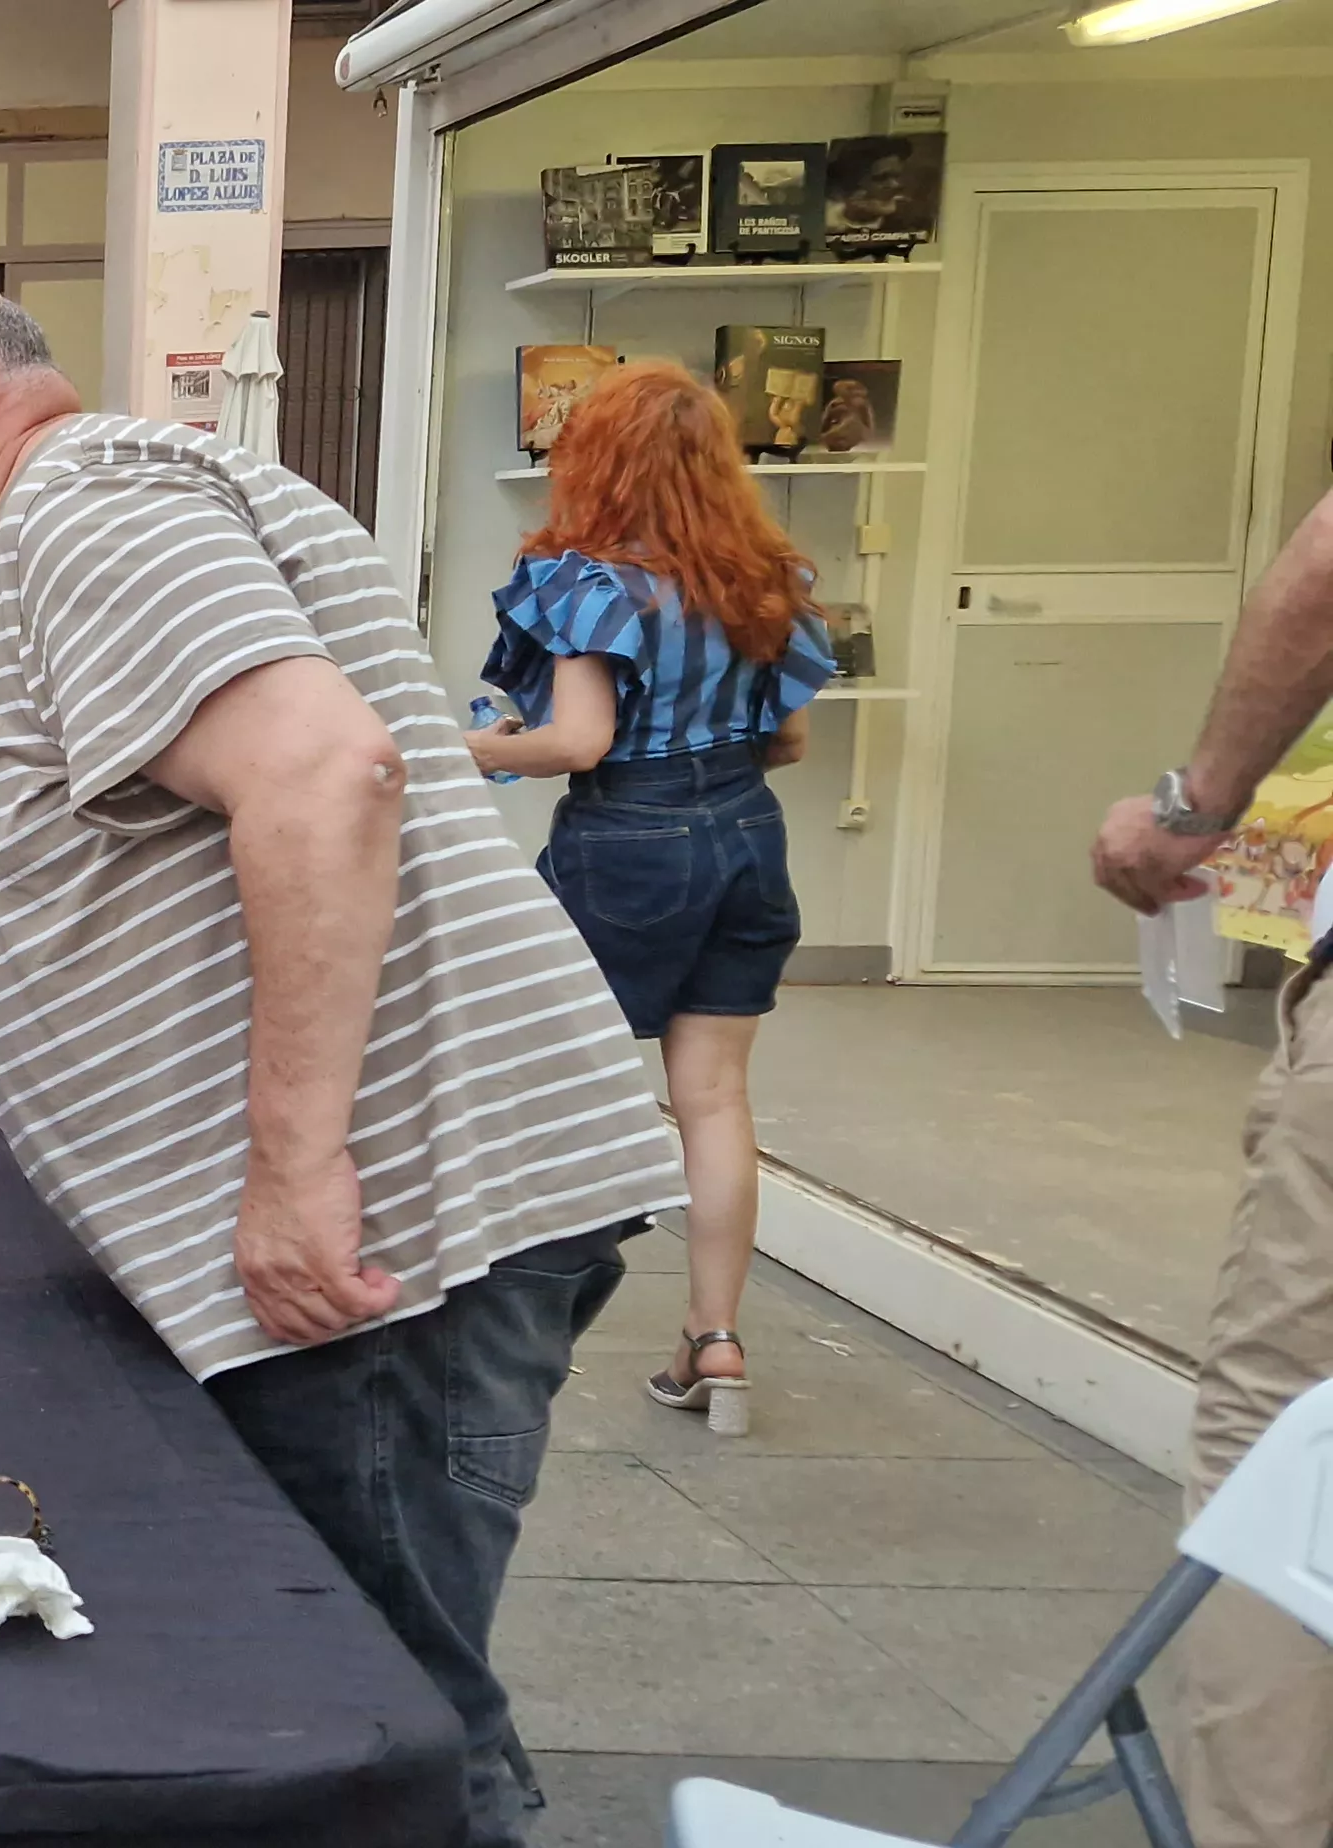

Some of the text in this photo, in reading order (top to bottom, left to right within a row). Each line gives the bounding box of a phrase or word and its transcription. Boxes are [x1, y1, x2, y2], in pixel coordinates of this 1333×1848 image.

[189, 151, 256, 165] PLAZA DE
[208, 167, 249, 182] LUIS
[555, 252, 611, 264] SKOGLER
[773, 335, 820, 346] SIGNOS
